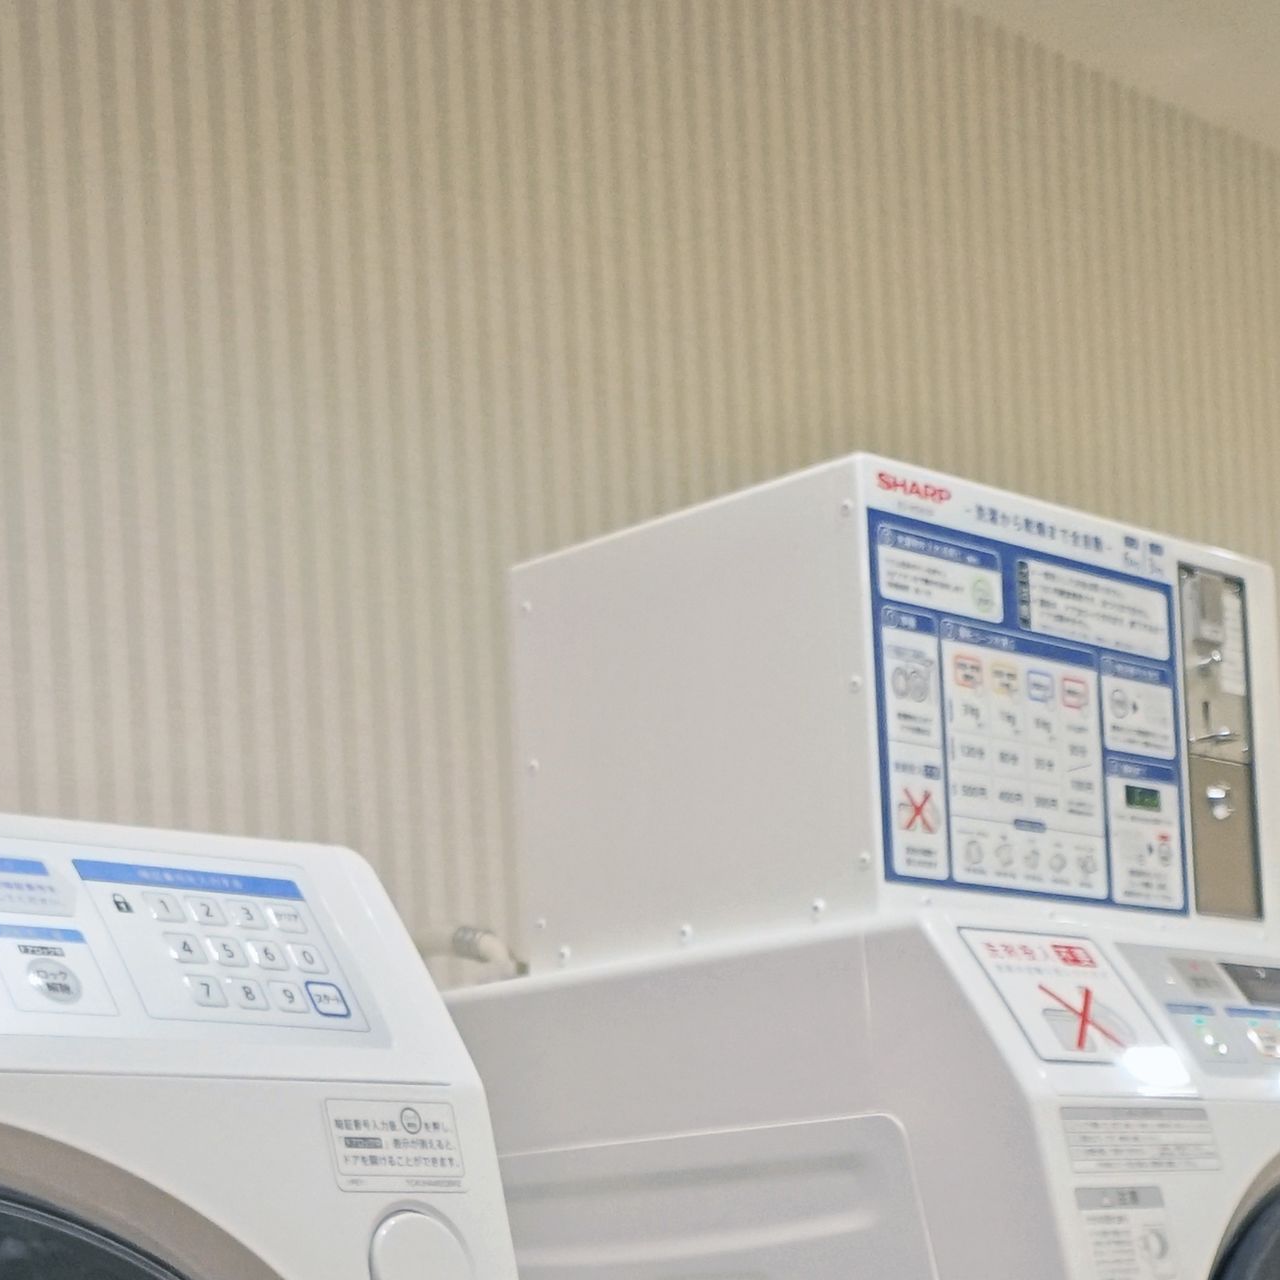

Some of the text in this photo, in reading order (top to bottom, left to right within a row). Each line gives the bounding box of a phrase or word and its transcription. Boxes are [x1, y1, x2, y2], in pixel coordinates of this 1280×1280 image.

[877, 471, 952, 503] SHARP
[199, 903, 215, 918] 2
[240, 906, 255, 922] 3
[181, 940, 194, 956] 4
[222, 943, 235, 959] 5
[263, 946, 276, 962] 6
[200, 982, 211, 999] 7
[241, 986, 256, 1002] 8
[281, 988, 296, 1004] 9
